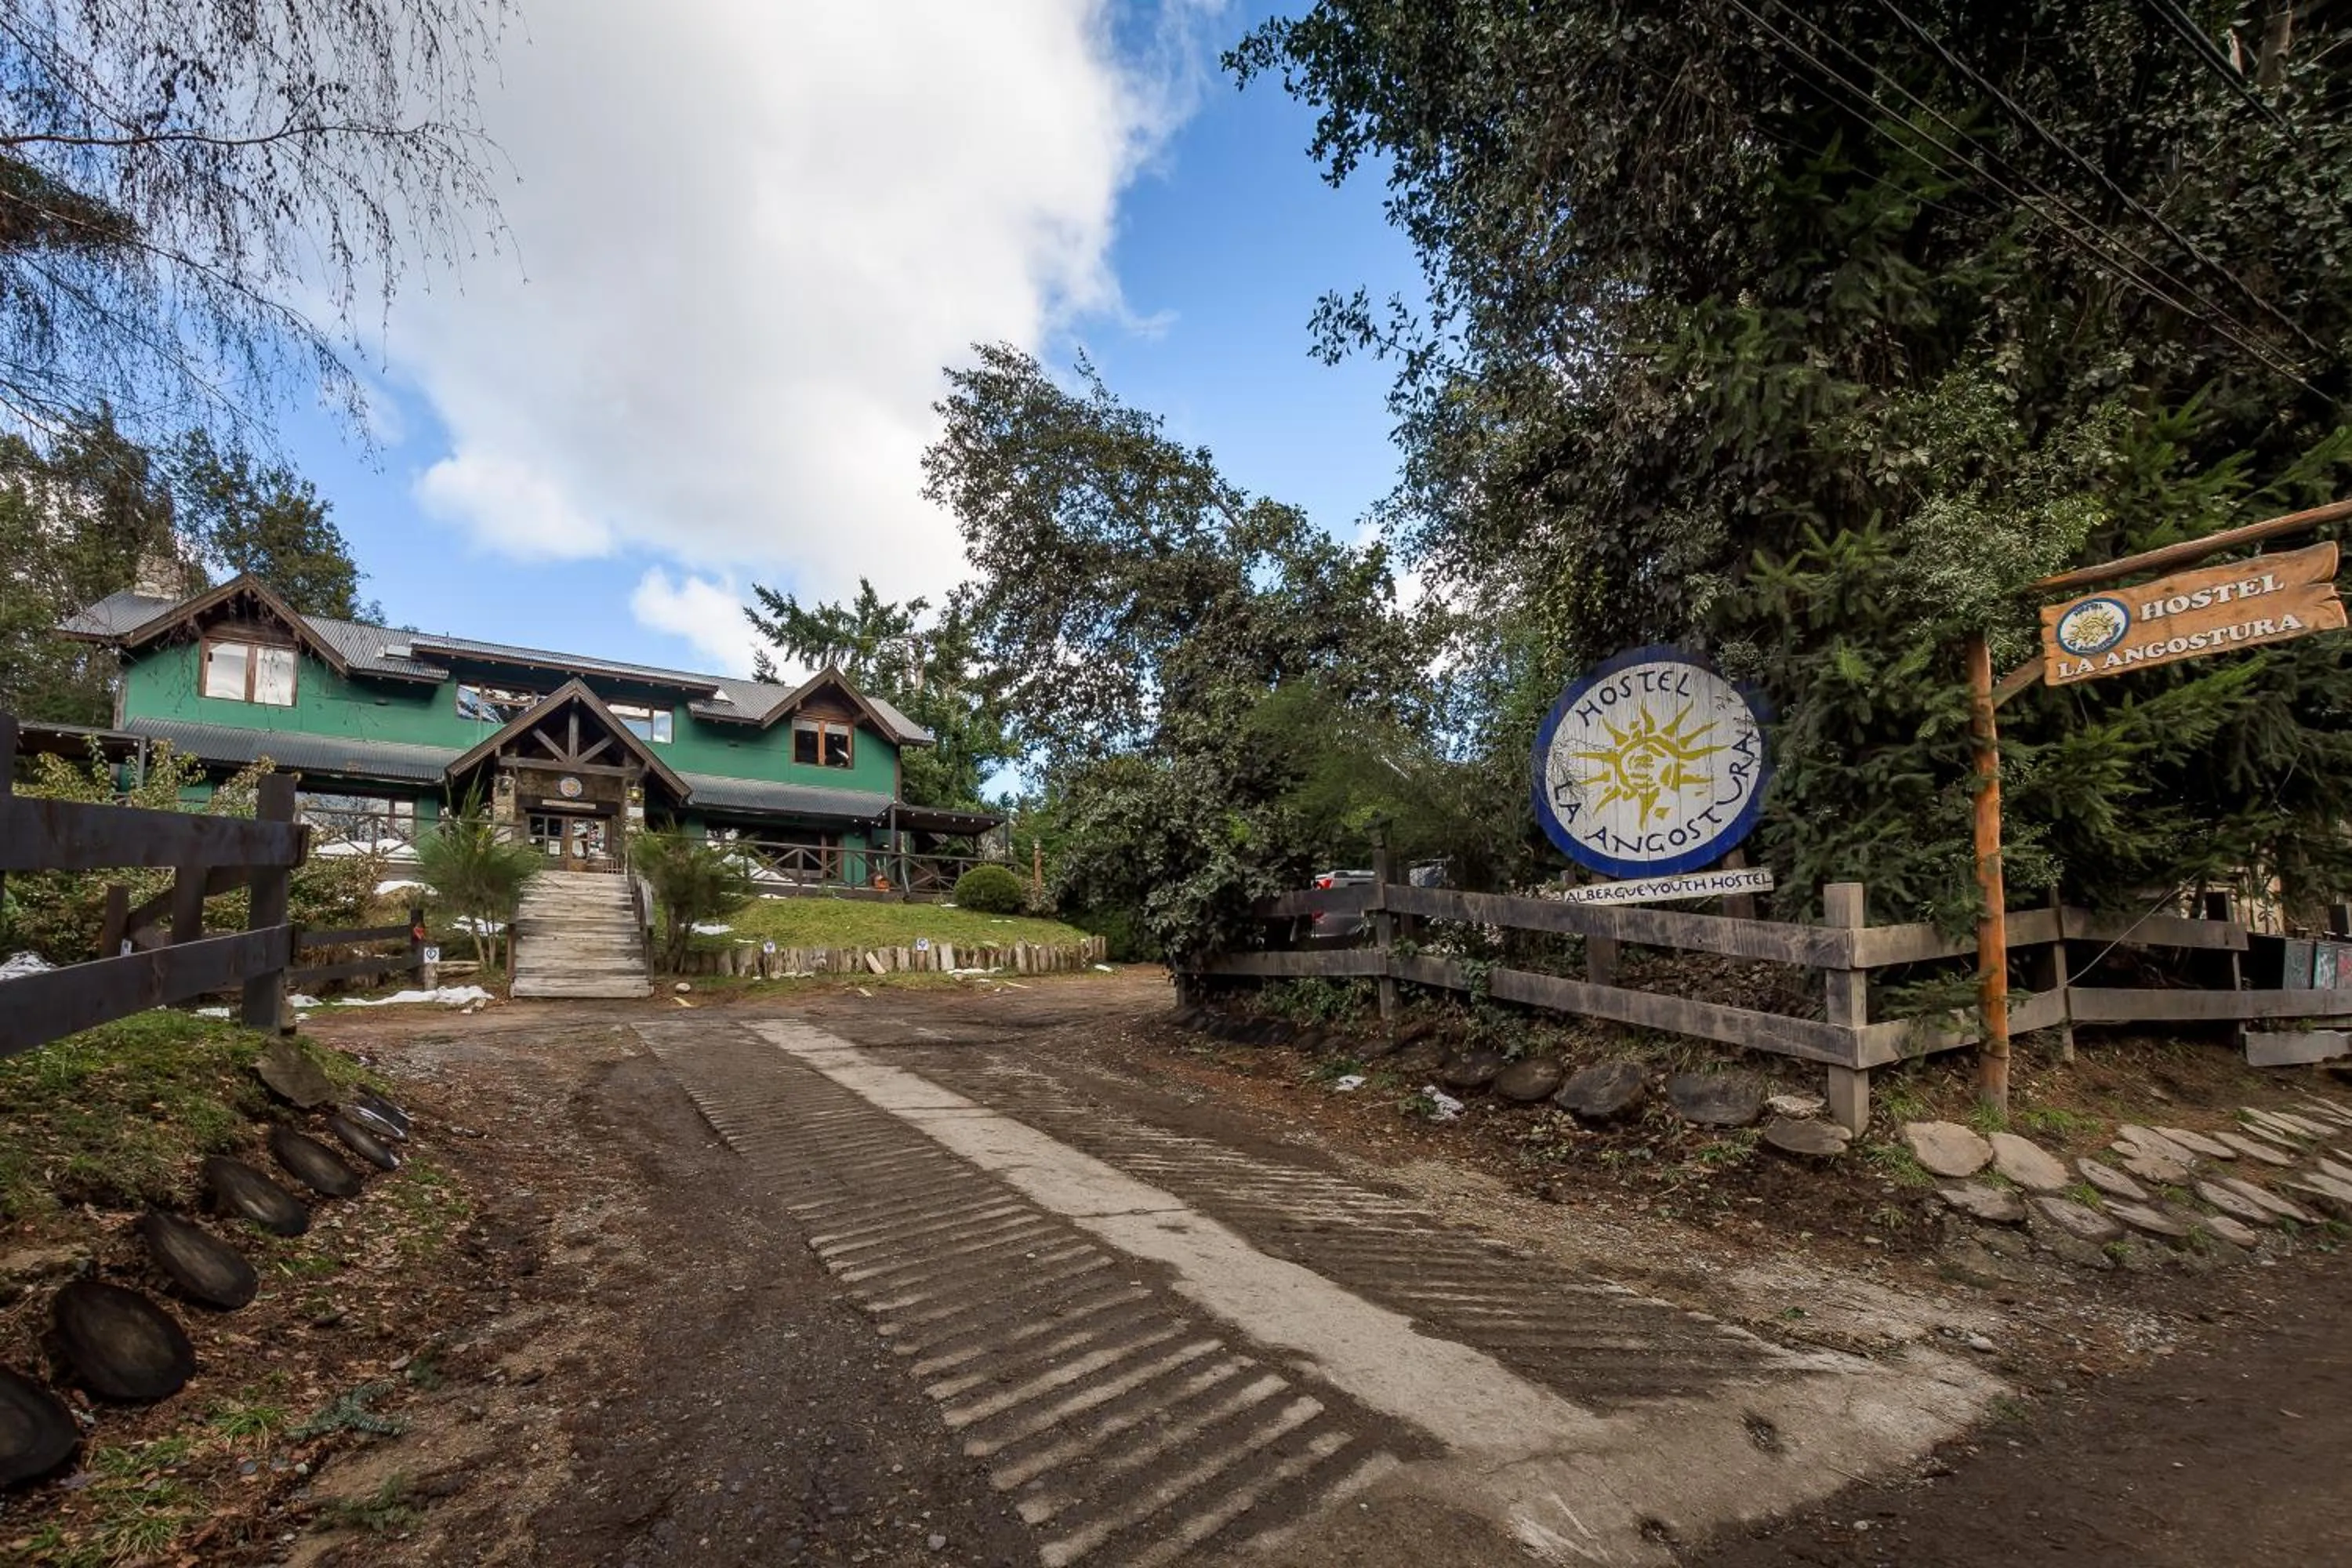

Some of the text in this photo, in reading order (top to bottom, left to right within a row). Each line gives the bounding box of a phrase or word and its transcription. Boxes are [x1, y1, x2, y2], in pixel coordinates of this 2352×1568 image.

[2140, 574, 2285, 622] HOSTEL
[2057, 657, 2095, 679] LA
[2101, 613, 2303, 670] ANGOSTURA
[1576, 670, 1690, 728] HOSTEL
[1554, 731, 1755, 854] LA ANGOSTURA
[1566, 873, 1772, 903] ALBERGUE YOUTH HOSTEL
